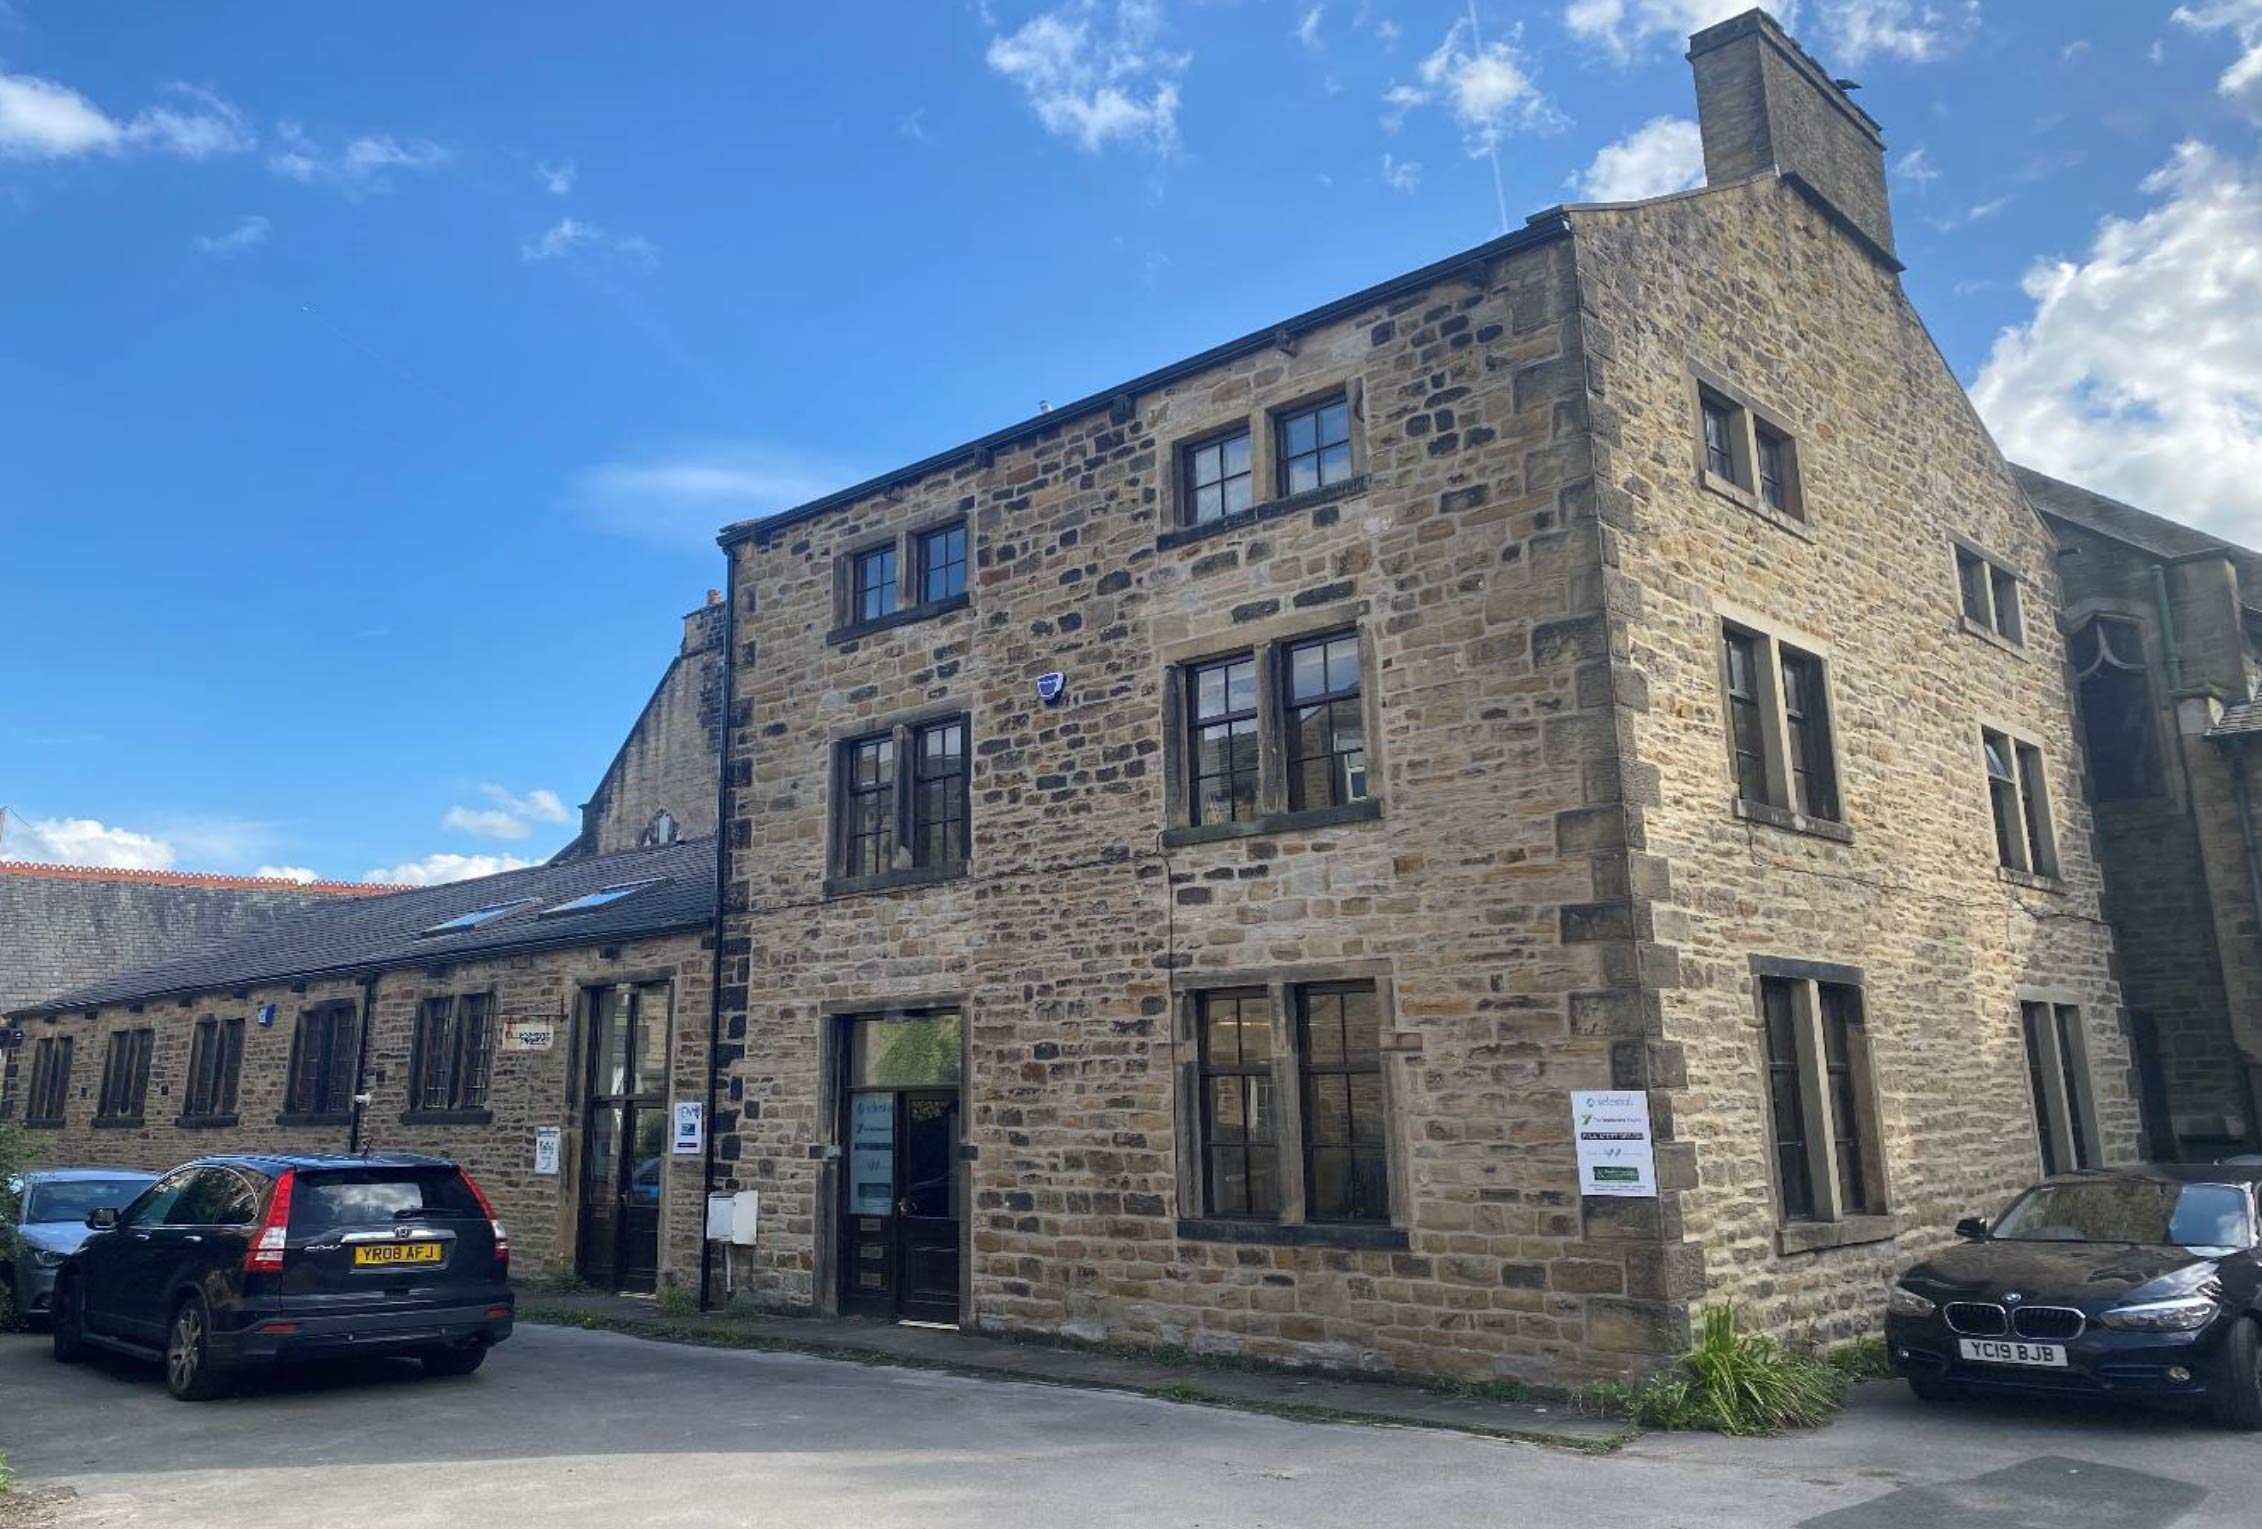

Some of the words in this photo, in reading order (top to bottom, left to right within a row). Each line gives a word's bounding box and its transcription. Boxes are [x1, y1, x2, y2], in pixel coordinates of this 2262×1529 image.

[363, 1246, 402, 1261] YR08
[405, 1244, 433, 1260] AFJ
[1971, 1341, 2012, 1359] YC19
[2016, 1344, 2054, 1362] BJB
